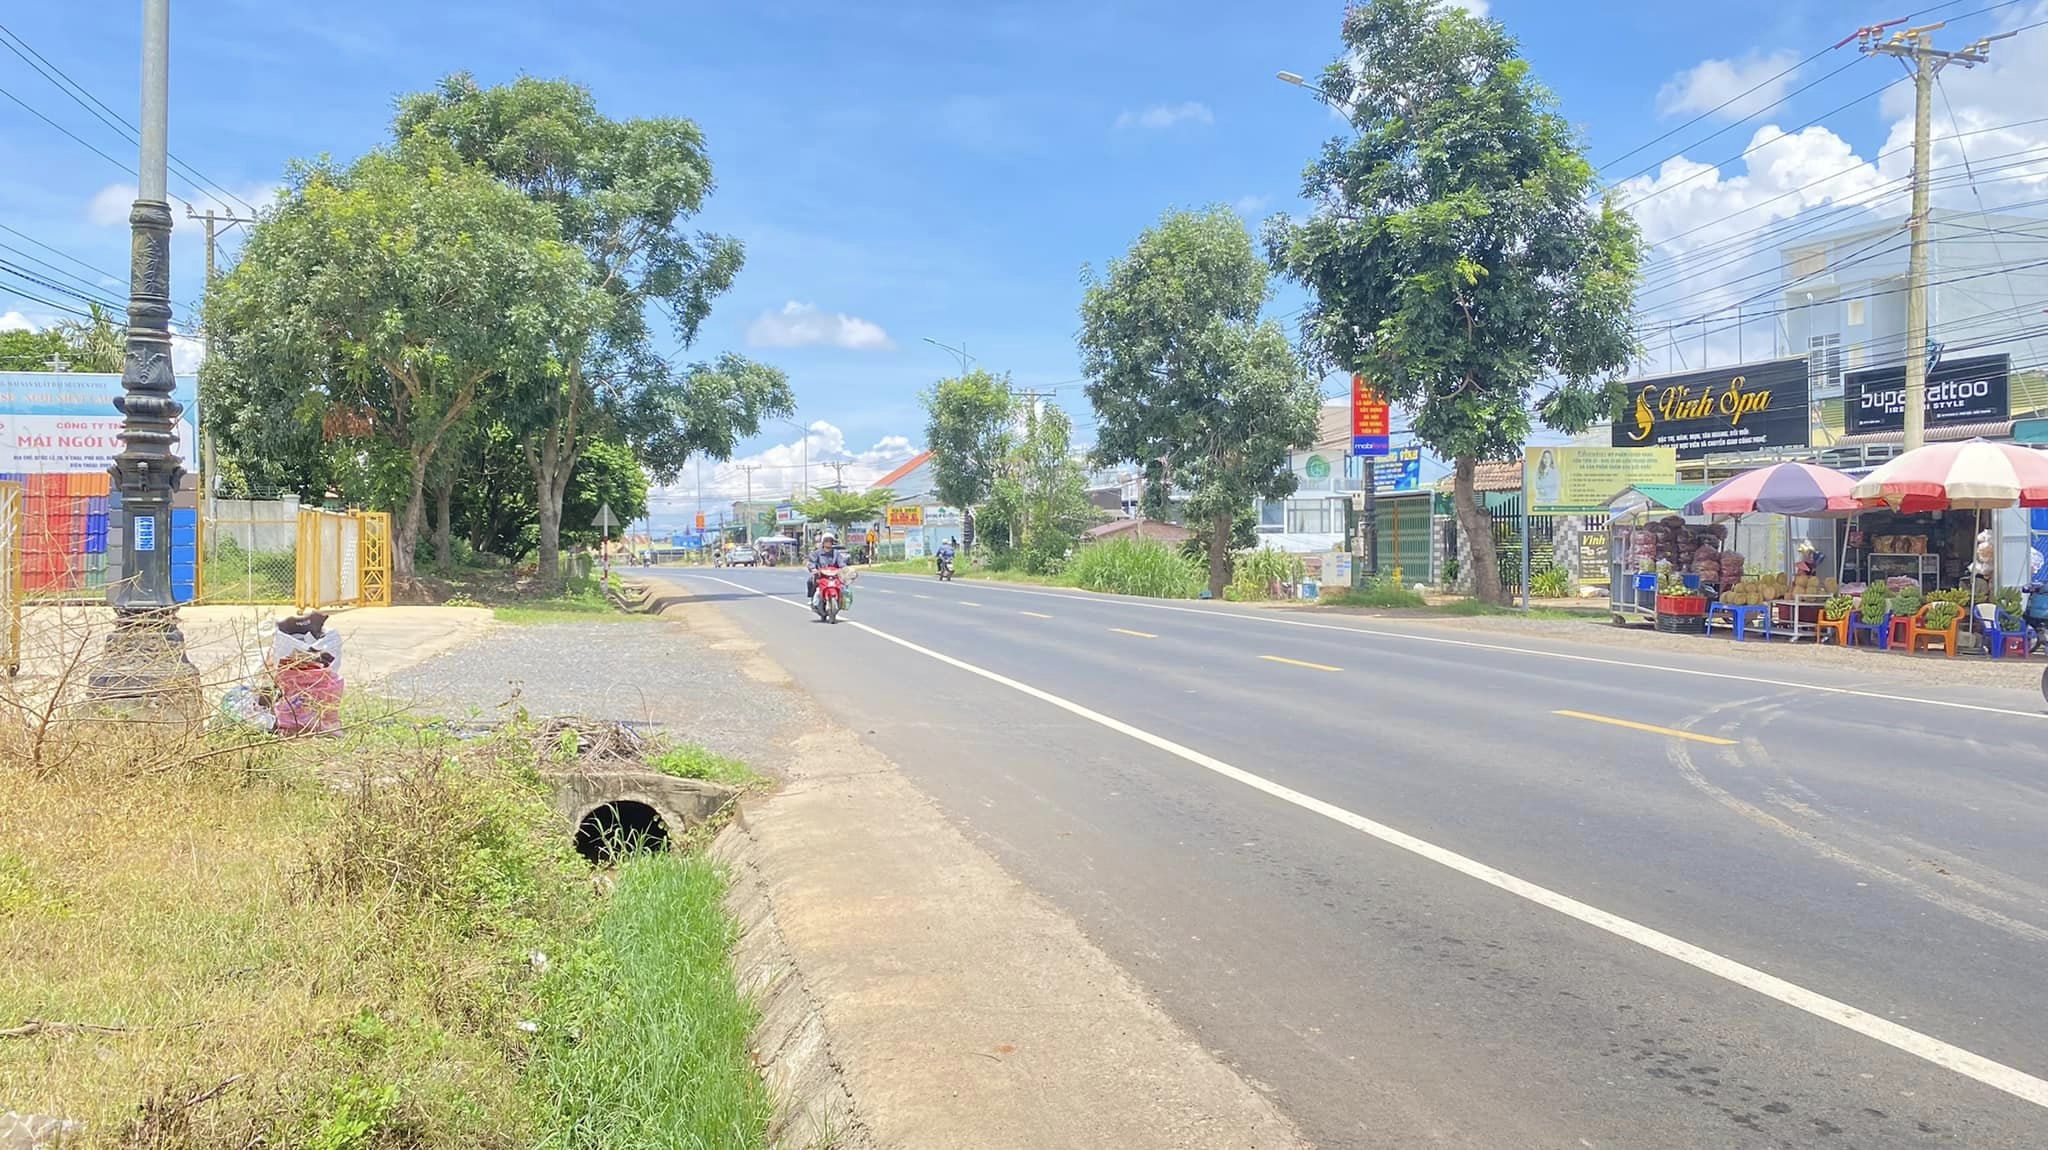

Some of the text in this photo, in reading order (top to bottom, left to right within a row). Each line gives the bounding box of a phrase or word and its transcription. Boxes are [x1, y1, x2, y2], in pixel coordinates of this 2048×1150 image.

[1659, 376, 1773, 425] Vinh Spa
[1933, 400, 1965, 410] STYLE
[56, 421, 88, 430] CÔNG
[92, 422, 104, 430] TY
[18, 433, 52, 448] MÁI
[58, 433, 103, 448] NGÓI
